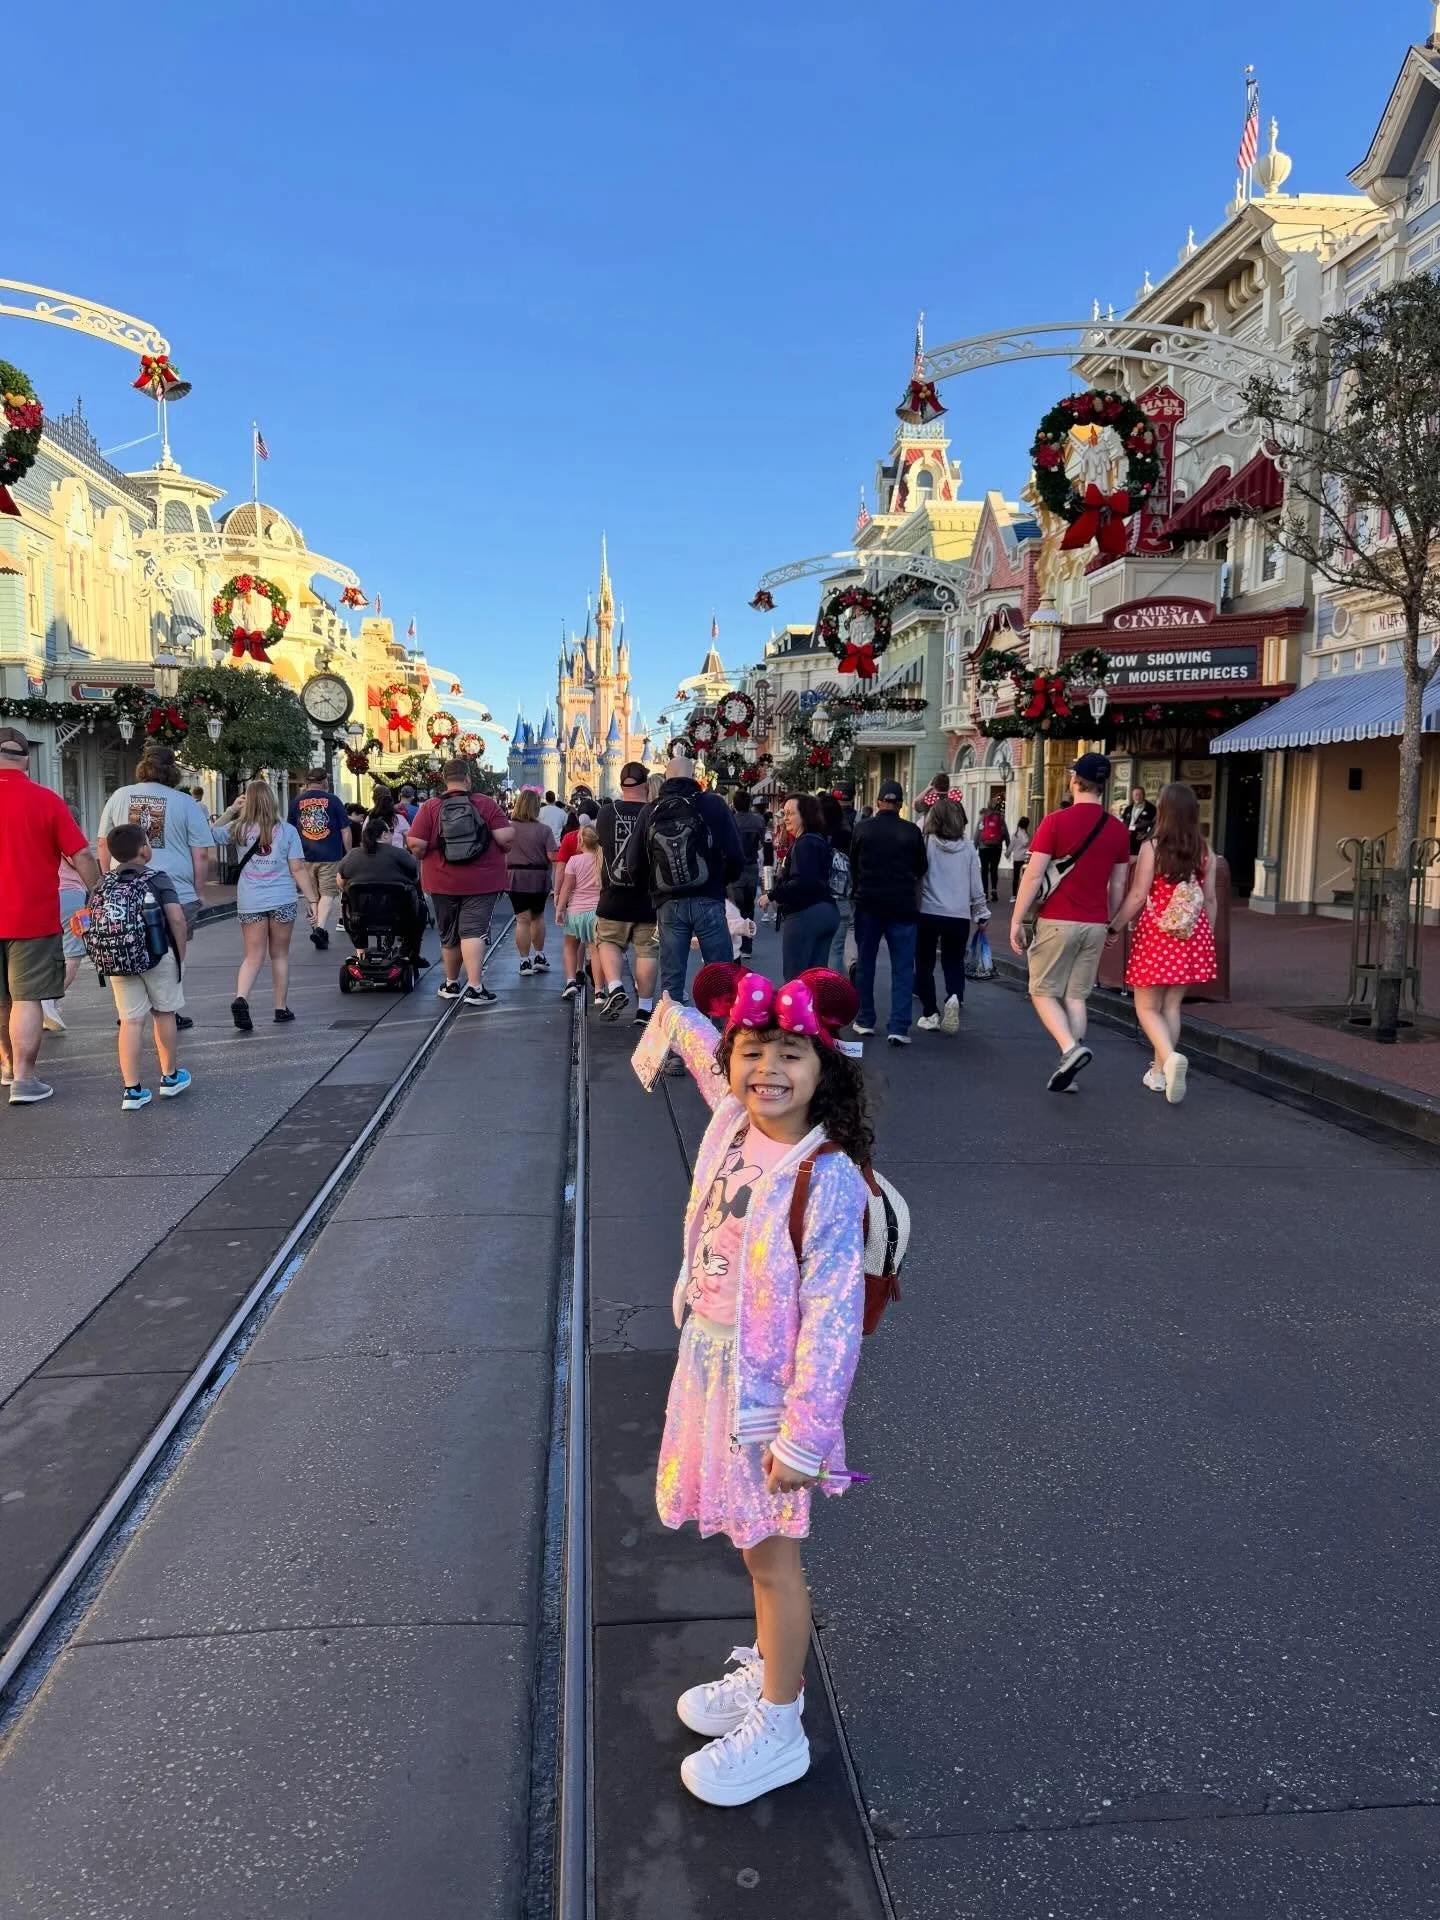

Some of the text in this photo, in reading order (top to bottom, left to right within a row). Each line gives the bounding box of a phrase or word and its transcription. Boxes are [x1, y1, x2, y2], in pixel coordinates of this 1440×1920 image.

[1141, 399, 1179, 411] MAIN
[1113, 610, 1206, 629] CINEMA
[1137, 606, 1168, 616] MAIN
[1107, 651, 1212, 668] NOW SHOWING
[1128, 666, 1249, 684] MOUSETERPIECES
